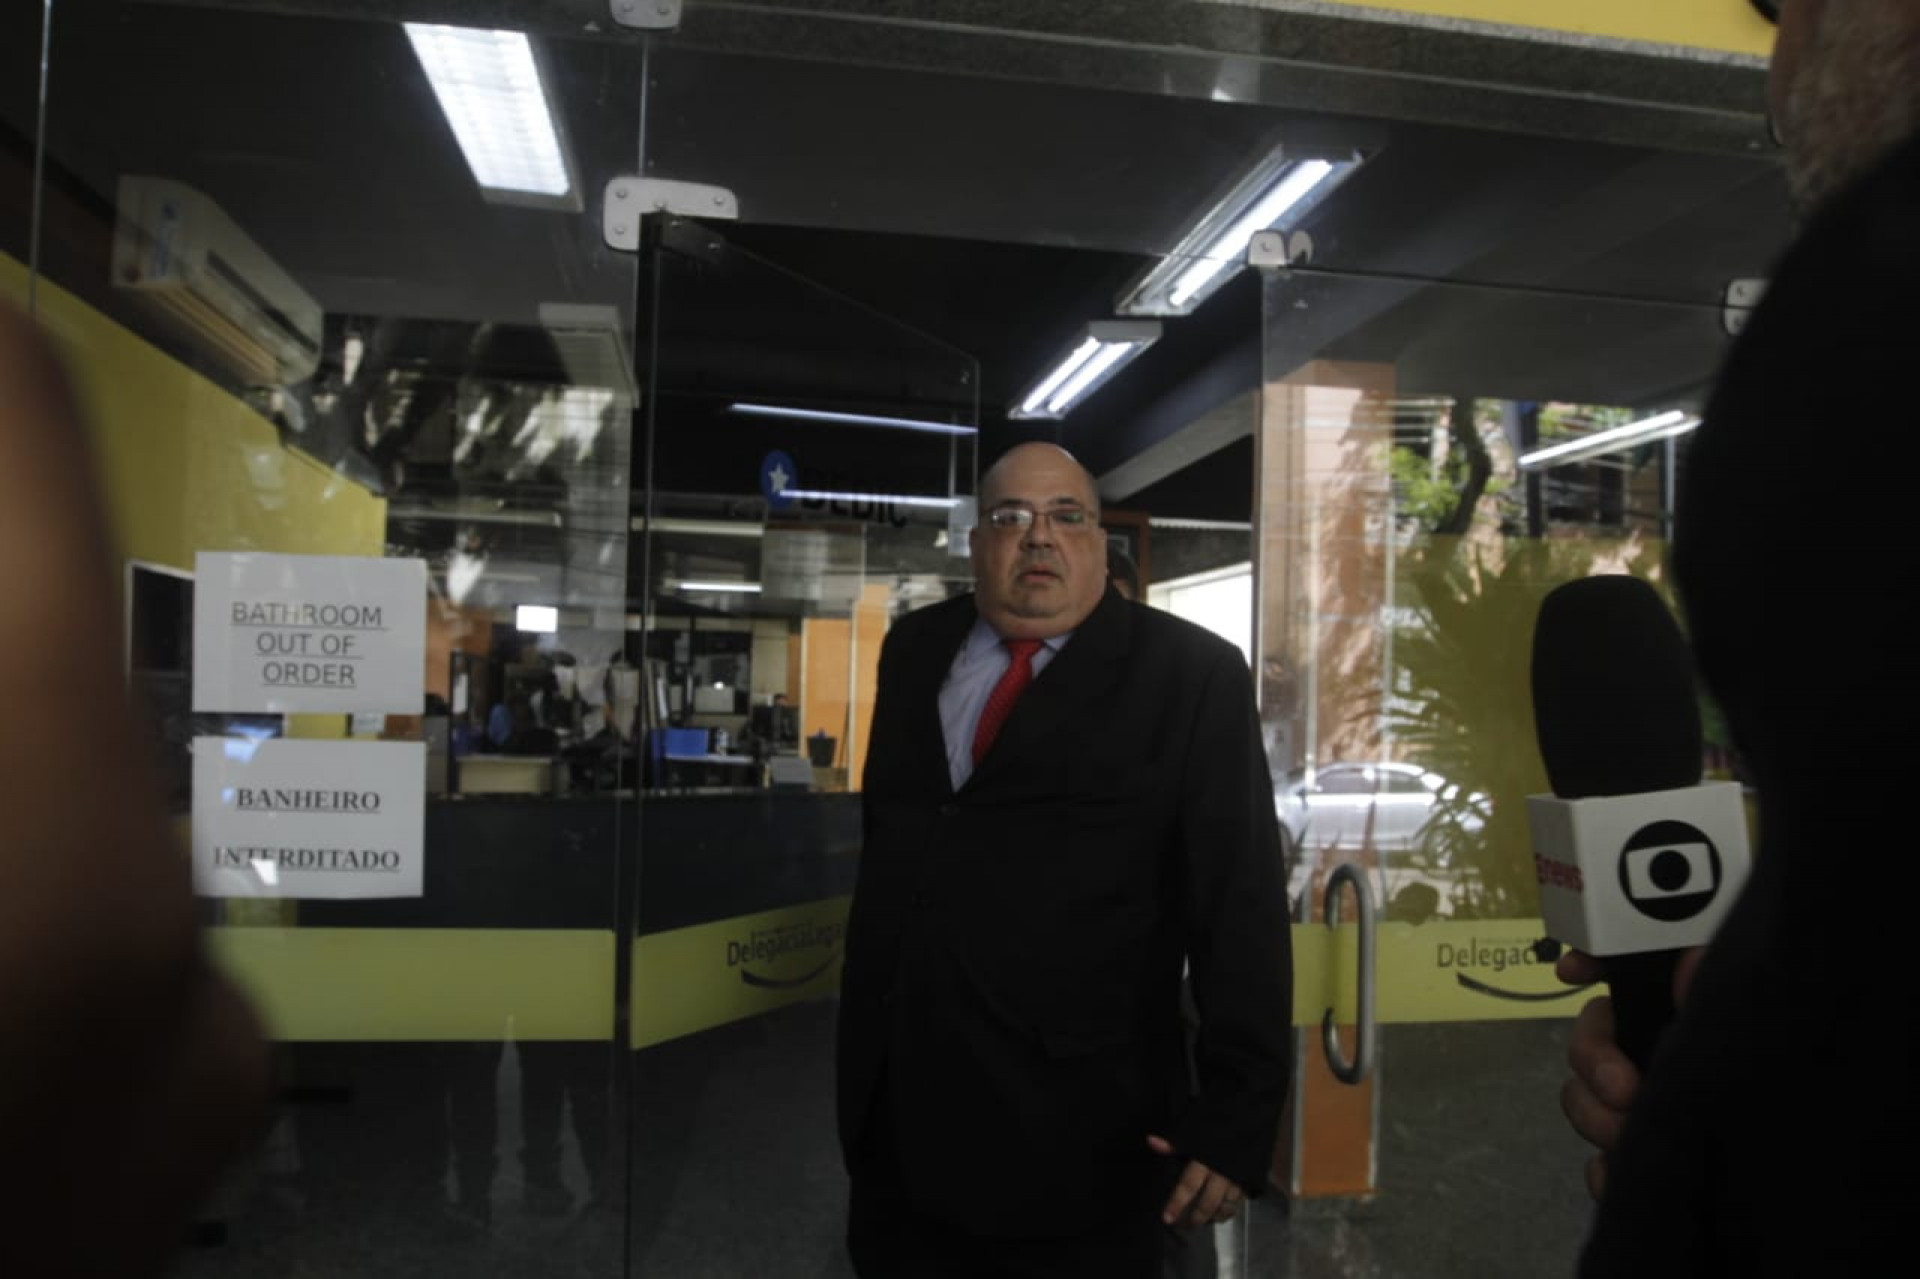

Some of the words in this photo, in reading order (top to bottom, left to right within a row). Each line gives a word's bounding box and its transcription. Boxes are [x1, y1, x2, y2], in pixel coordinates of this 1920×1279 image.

[231, 601, 382, 627] BATHROOM
[256, 632, 311, 655] OUT
[321, 633, 356, 655] OF
[263, 661, 356, 687] ORDER
[237, 789, 380, 811] BANHEIRO
[214, 846, 400, 870] INTERDITADO
[1437, 936, 1536, 971] Delegac
